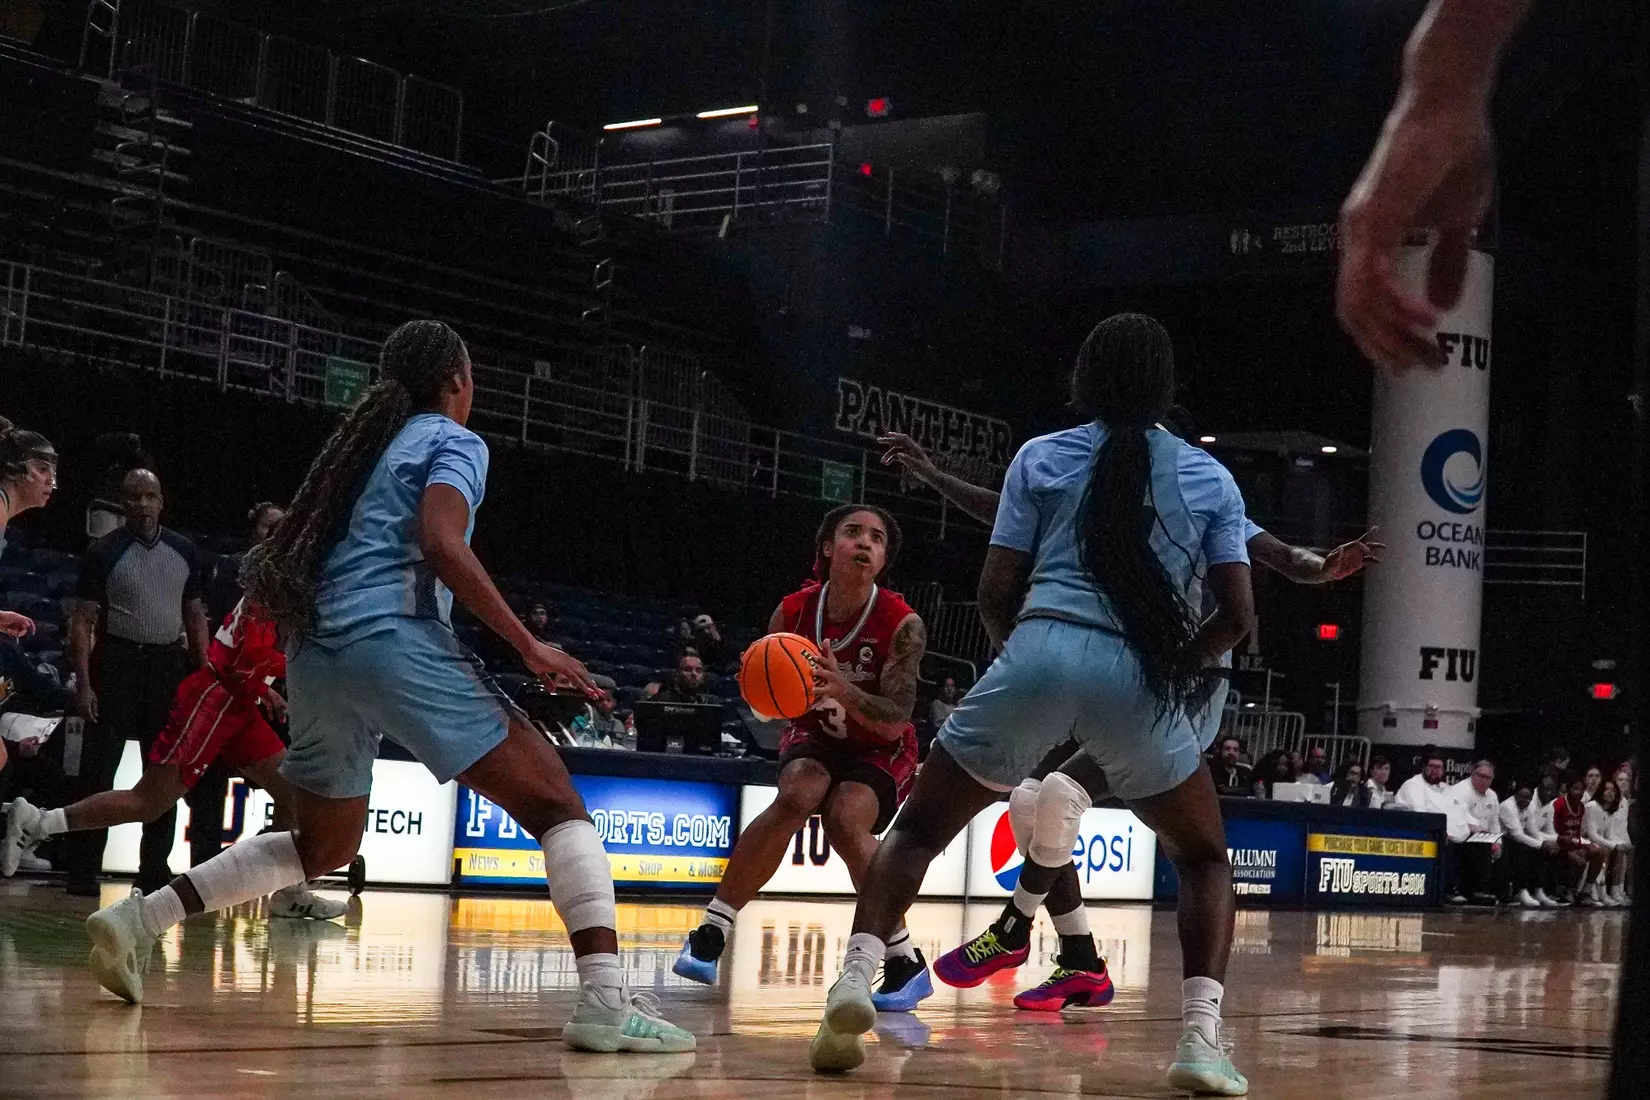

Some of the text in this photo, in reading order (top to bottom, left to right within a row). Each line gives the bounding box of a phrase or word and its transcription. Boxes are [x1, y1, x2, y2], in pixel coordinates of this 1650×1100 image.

[1436, 332, 1489, 371] FIU
[835, 376, 1014, 472] PANTHER
[1417, 520, 1484, 546] OCEAN
[1425, 546, 1480, 570] BANK
[1419, 647, 1476, 682] FIU
[792, 816, 830, 866] IU
[1071, 825, 1132, 884] epsi
[1233, 848, 1277, 867] ALUMNI
[1232, 869, 1276, 879] ASSOCIATION
